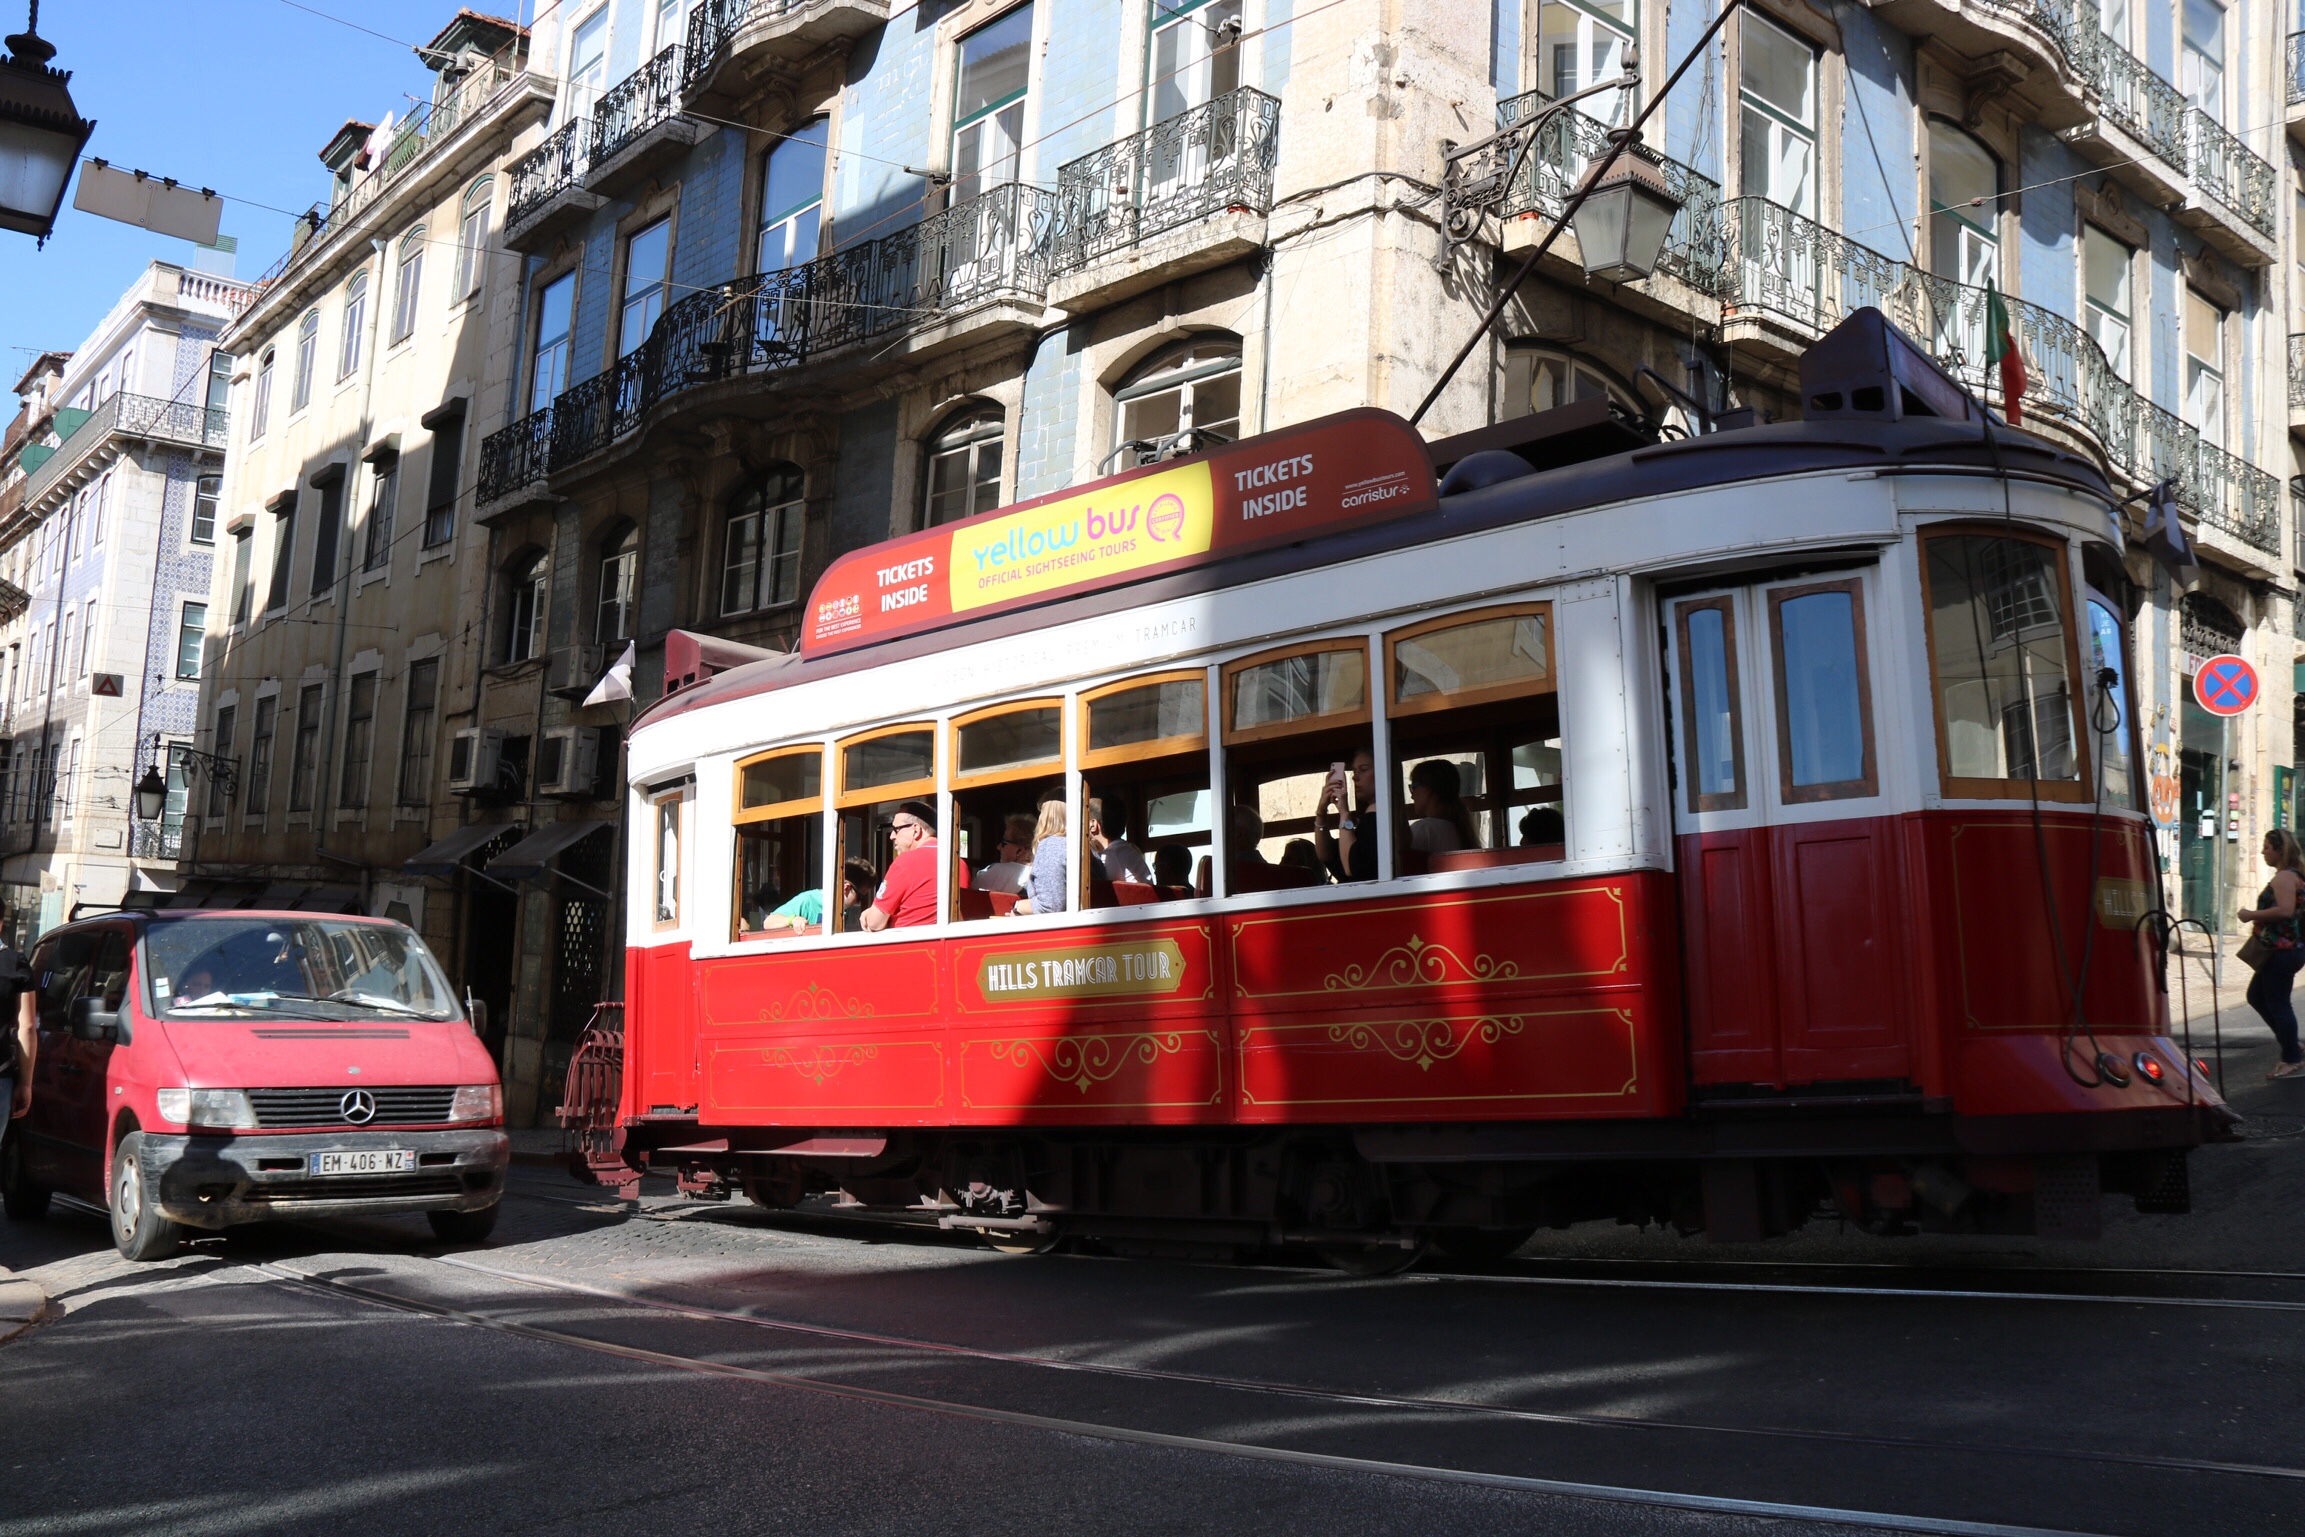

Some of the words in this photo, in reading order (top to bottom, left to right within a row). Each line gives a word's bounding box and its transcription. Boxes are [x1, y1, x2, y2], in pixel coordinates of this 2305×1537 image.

[1234, 453, 1314, 491] TICKETS
[1243, 485, 1307, 520] INSIDE
[1341, 486, 1399, 508] carristur
[973, 521, 1079, 571] yellow
[1086, 504, 1140, 540] bus
[876, 556, 934, 587] TICKETS
[978, 567, 1023, 589] OFFICIAL
[1025, 549, 1095, 577] SIGHTSEEING
[1098, 538, 1137, 558] TOURS
[881, 583, 928, 612] INSIDE
[931, 664, 975, 687] LSBON
[1135, 616, 1197, 644] TRAMCAR
[2102, 889, 2138, 917] HILLS
[988, 962, 1038, 991] HILLS
[1041, 956, 1118, 987] TRAMCAR
[1122, 951, 1171, 982] TOUR
